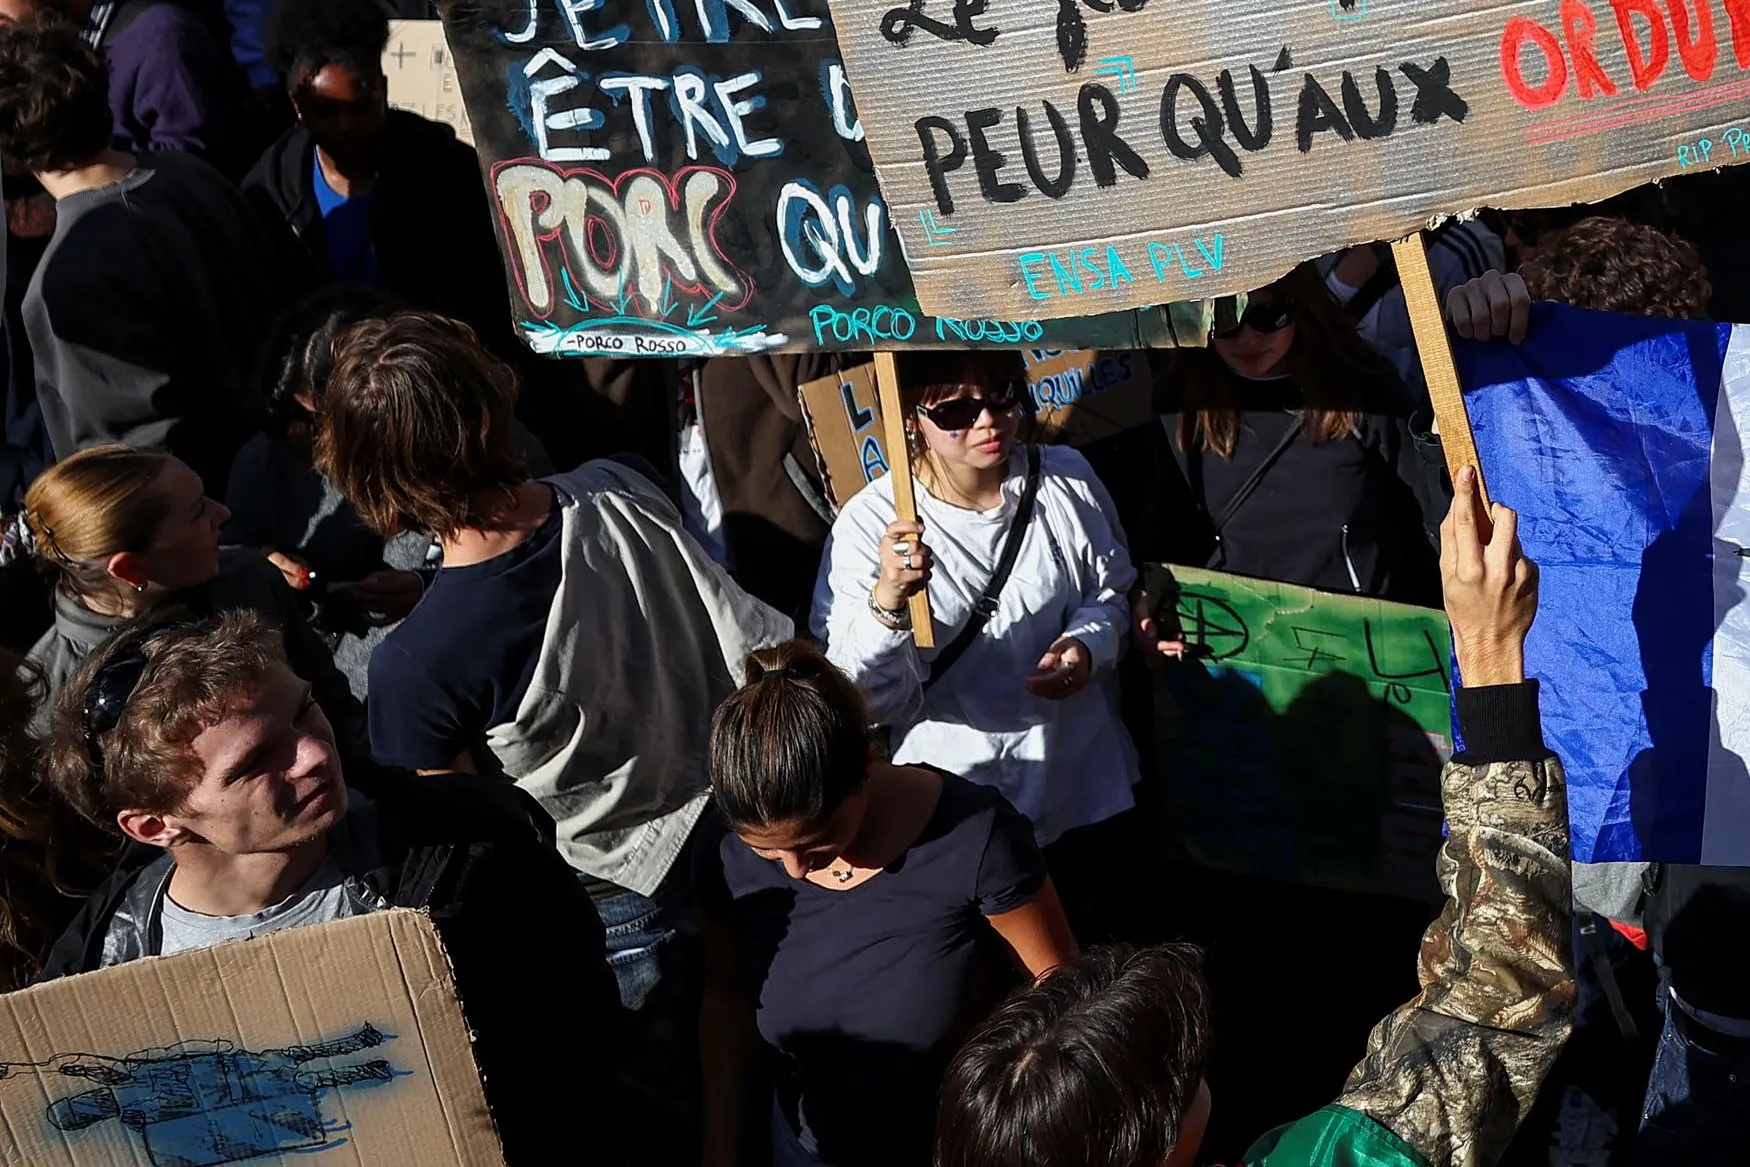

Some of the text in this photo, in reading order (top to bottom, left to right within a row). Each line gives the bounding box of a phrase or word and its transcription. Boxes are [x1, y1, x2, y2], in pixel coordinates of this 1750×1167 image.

[520, 46, 785, 163] ÊTRE
[914, 81, 1150, 218] PEUR
[1161, 45, 1469, 179] QU'AUX
[774, 181, 884, 286] QU
[1017, 234, 1224, 301] ENSA PLV
[635, 336, 688, 354] ROSSO
[808, 303, 917, 346] PORCO
